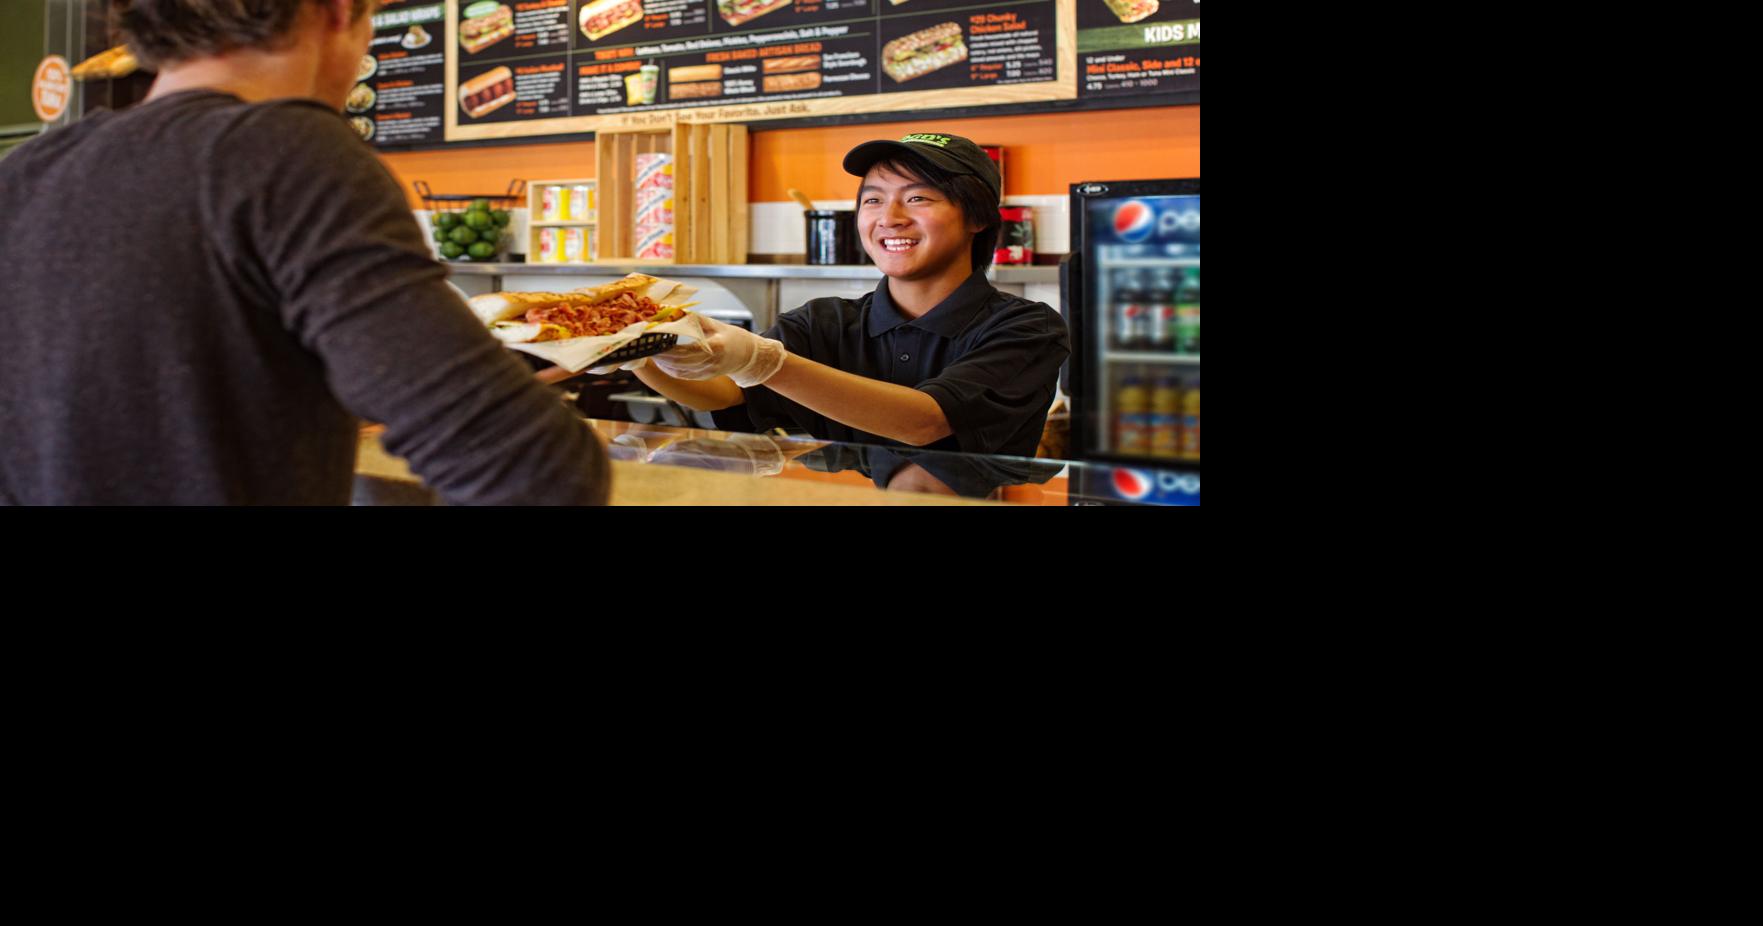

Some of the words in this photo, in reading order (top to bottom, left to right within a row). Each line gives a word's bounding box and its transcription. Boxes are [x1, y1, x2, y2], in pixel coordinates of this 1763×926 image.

[987, 13, 1017, 23] Chunky
[821, 25, 848, 36] Pepper
[970, 24, 1002, 33] Chicken
[1003, 20, 1027, 31] Salad
[1144, 25, 1184, 43] KIDS
[1087, 64, 1105, 74] Mini
[1142, 60, 1162, 70] Side
[1164, 58, 1182, 69] and
[1183, 57, 1194, 67] 12
[696, 111, 716, 120] Your
[765, 106, 786, 116] Just
